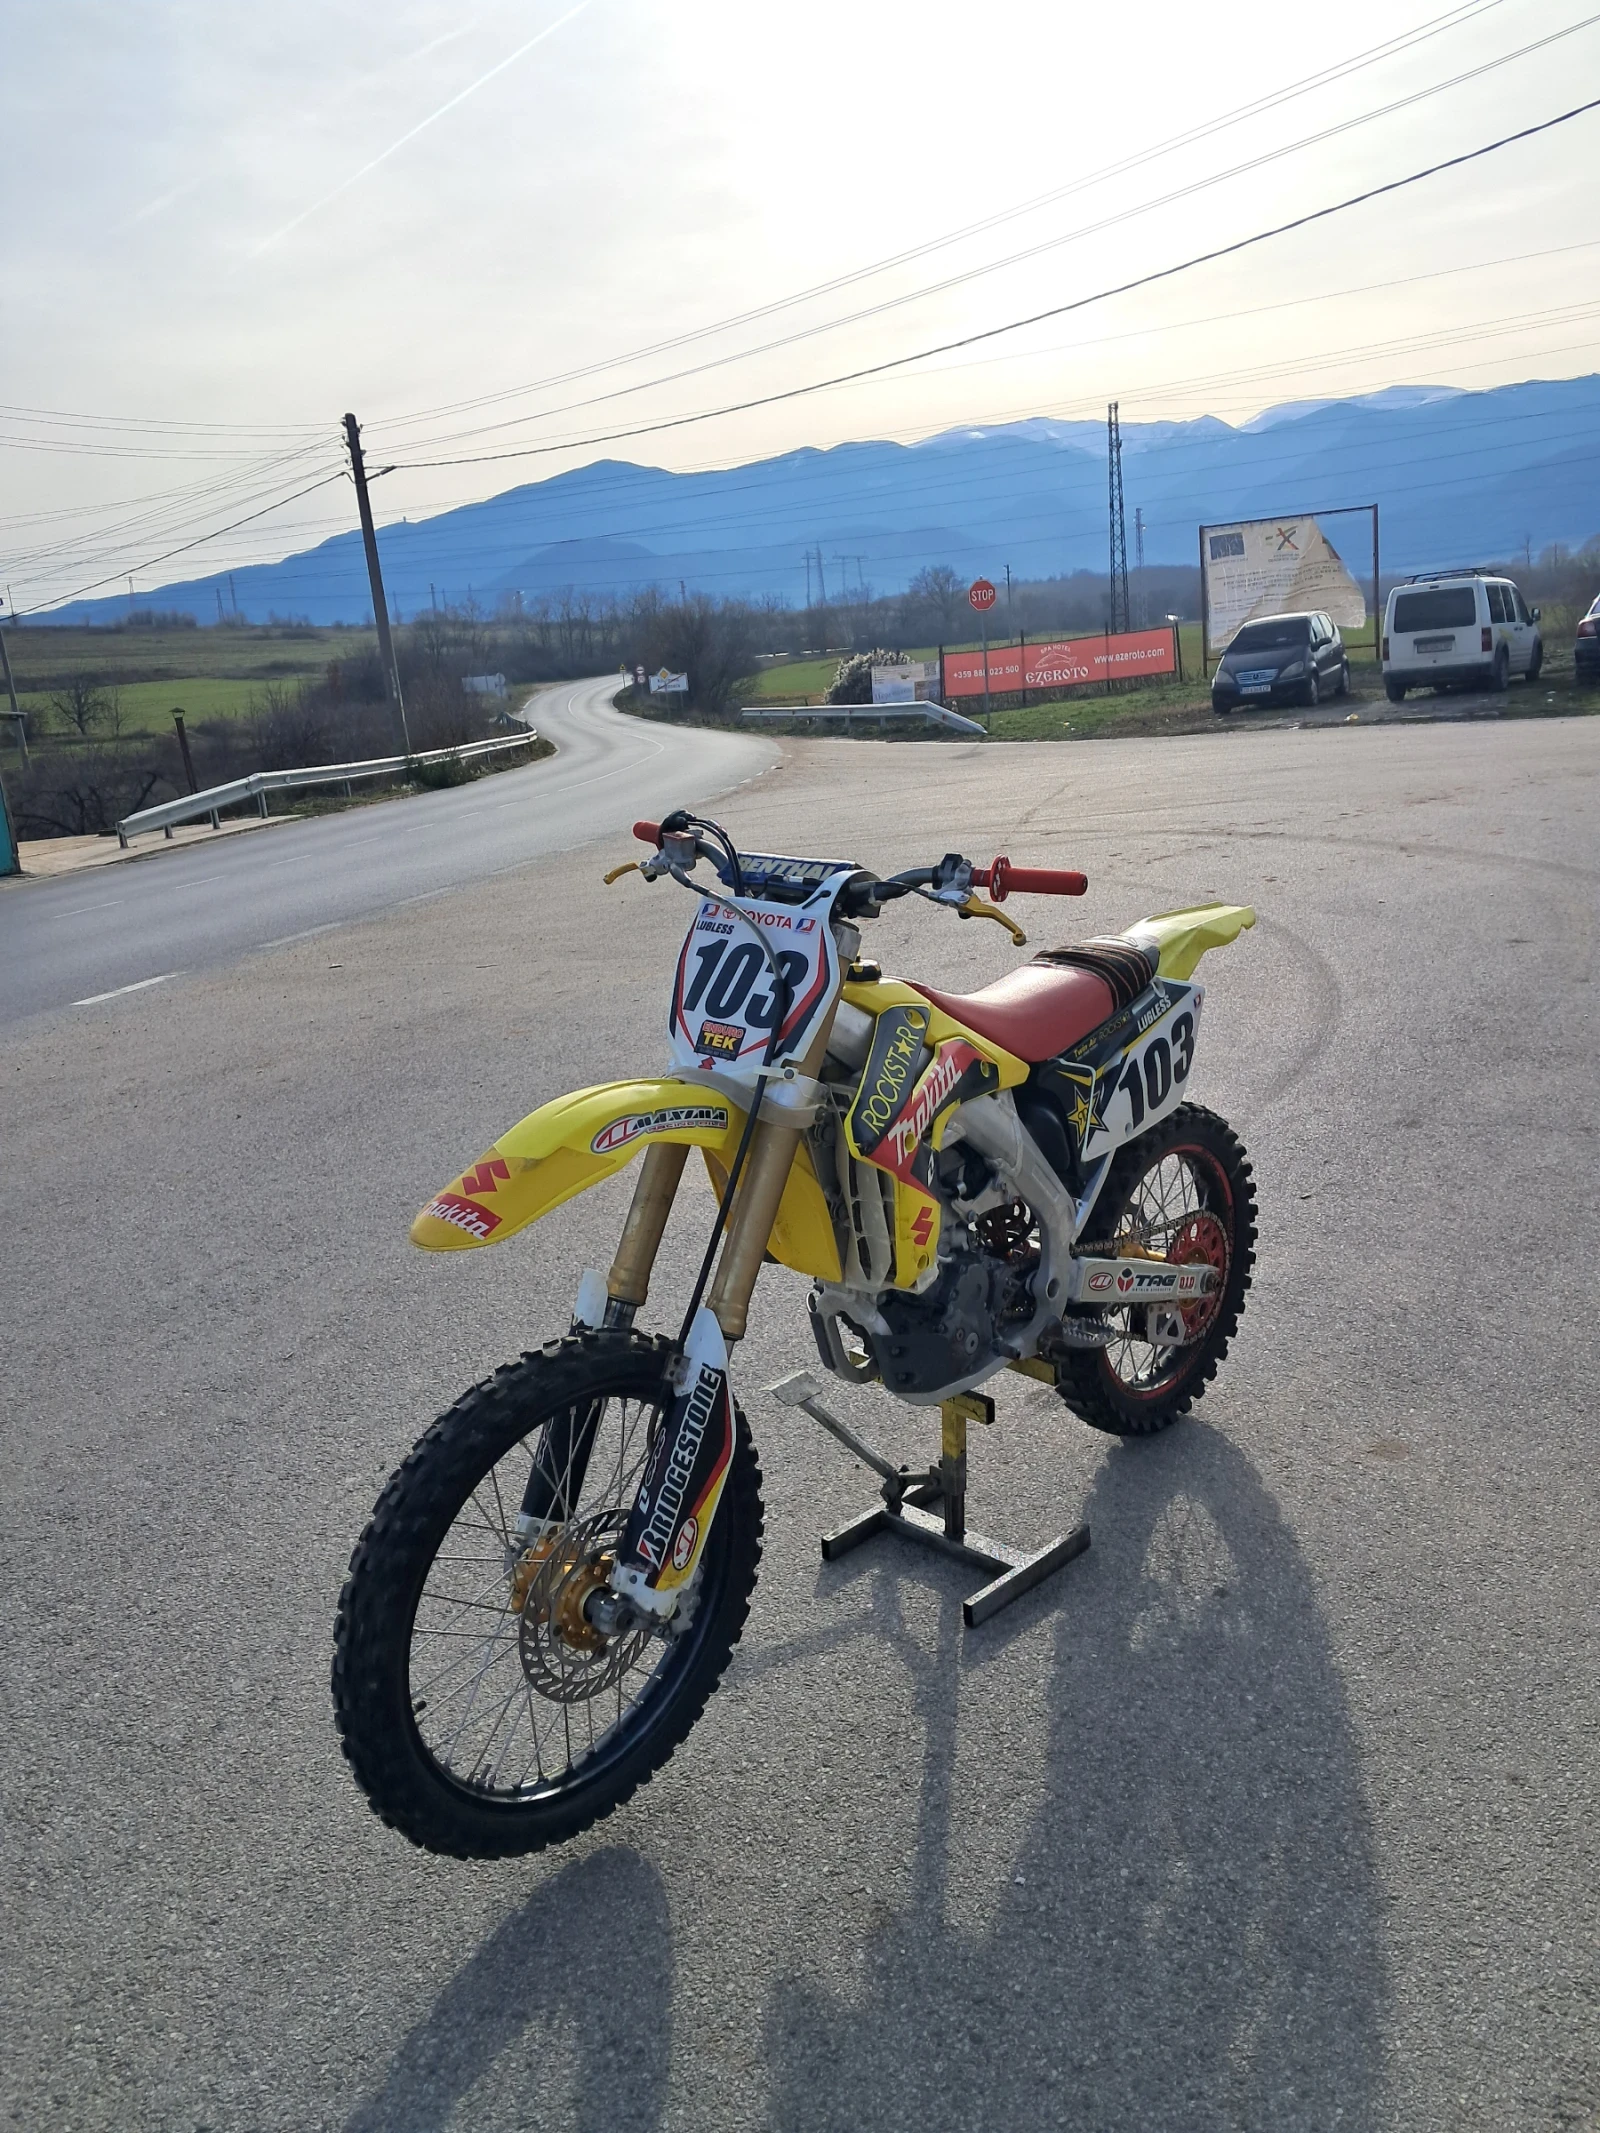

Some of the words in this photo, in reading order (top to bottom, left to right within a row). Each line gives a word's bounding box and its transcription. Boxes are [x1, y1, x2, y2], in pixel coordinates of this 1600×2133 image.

[971, 589, 994, 602] STOP
[1052, 644, 1071, 653] HOTEL
[1093, 647, 1165, 664] www.ezeroto.com
[953, 670, 972, 679] +359
[989, 667, 1003, 676] 022
[1005, 664, 1020, 674] 500
[1025, 665, 1089, 686] EZEROTO
[683, 938, 809, 1029] 103
[702, 1021, 744, 1039] ENDURO
[703, 1032, 737, 1051] TEK
[1118, 1011, 1195, 1130] 103
[697, 1120, 727, 1129] OILS
[1135, 1274, 1177, 1287] TAG
[636, 1366, 722, 1571] BRIDGESTONE
